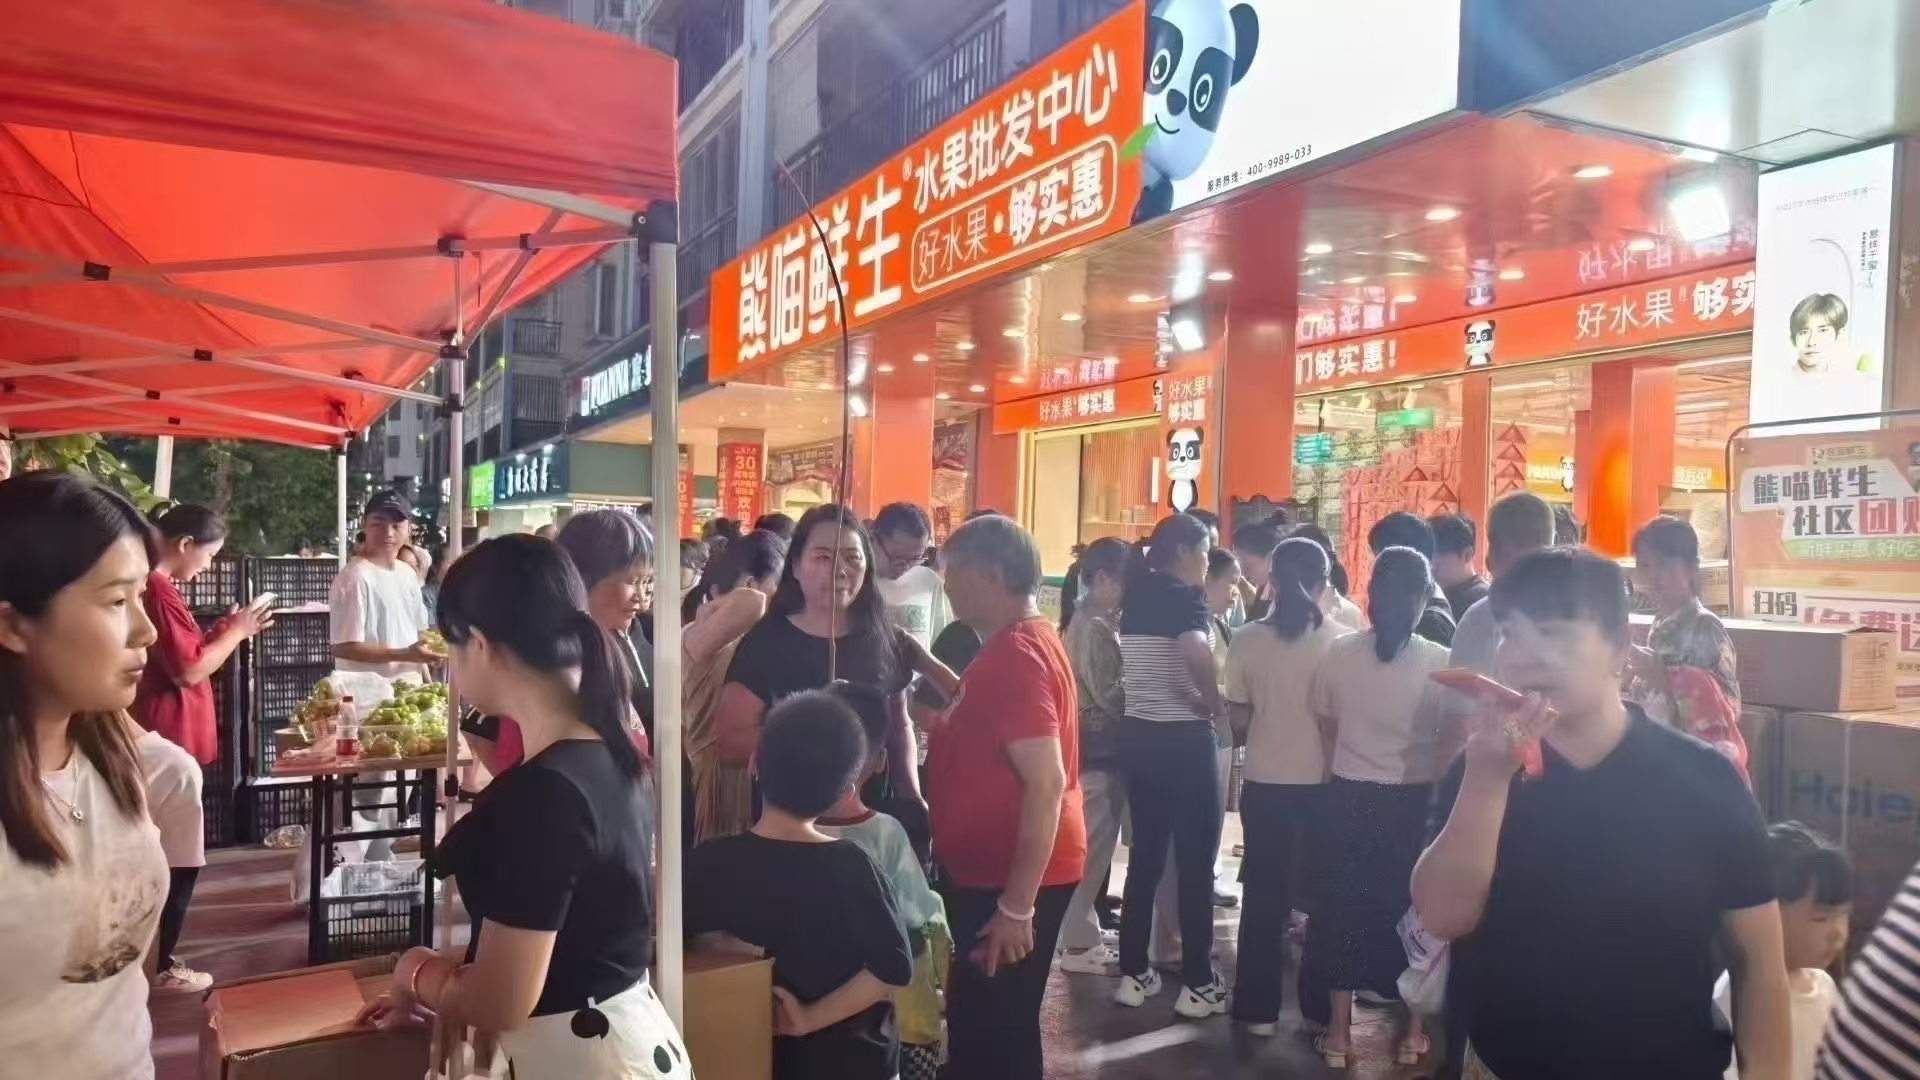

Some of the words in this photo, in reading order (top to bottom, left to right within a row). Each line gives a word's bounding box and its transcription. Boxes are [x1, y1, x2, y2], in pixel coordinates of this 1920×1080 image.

[912, 41, 1119, 215] 水果批发中心
[1247, 143, 1312, 177] 400-9989-033
[738, 175, 902, 362] 熊喵鲜生
[735, 455, 756, 471] 30
[1753, 464, 1881, 505] 熊喵鲜生
[1789, 768, 1919, 822] Haie
